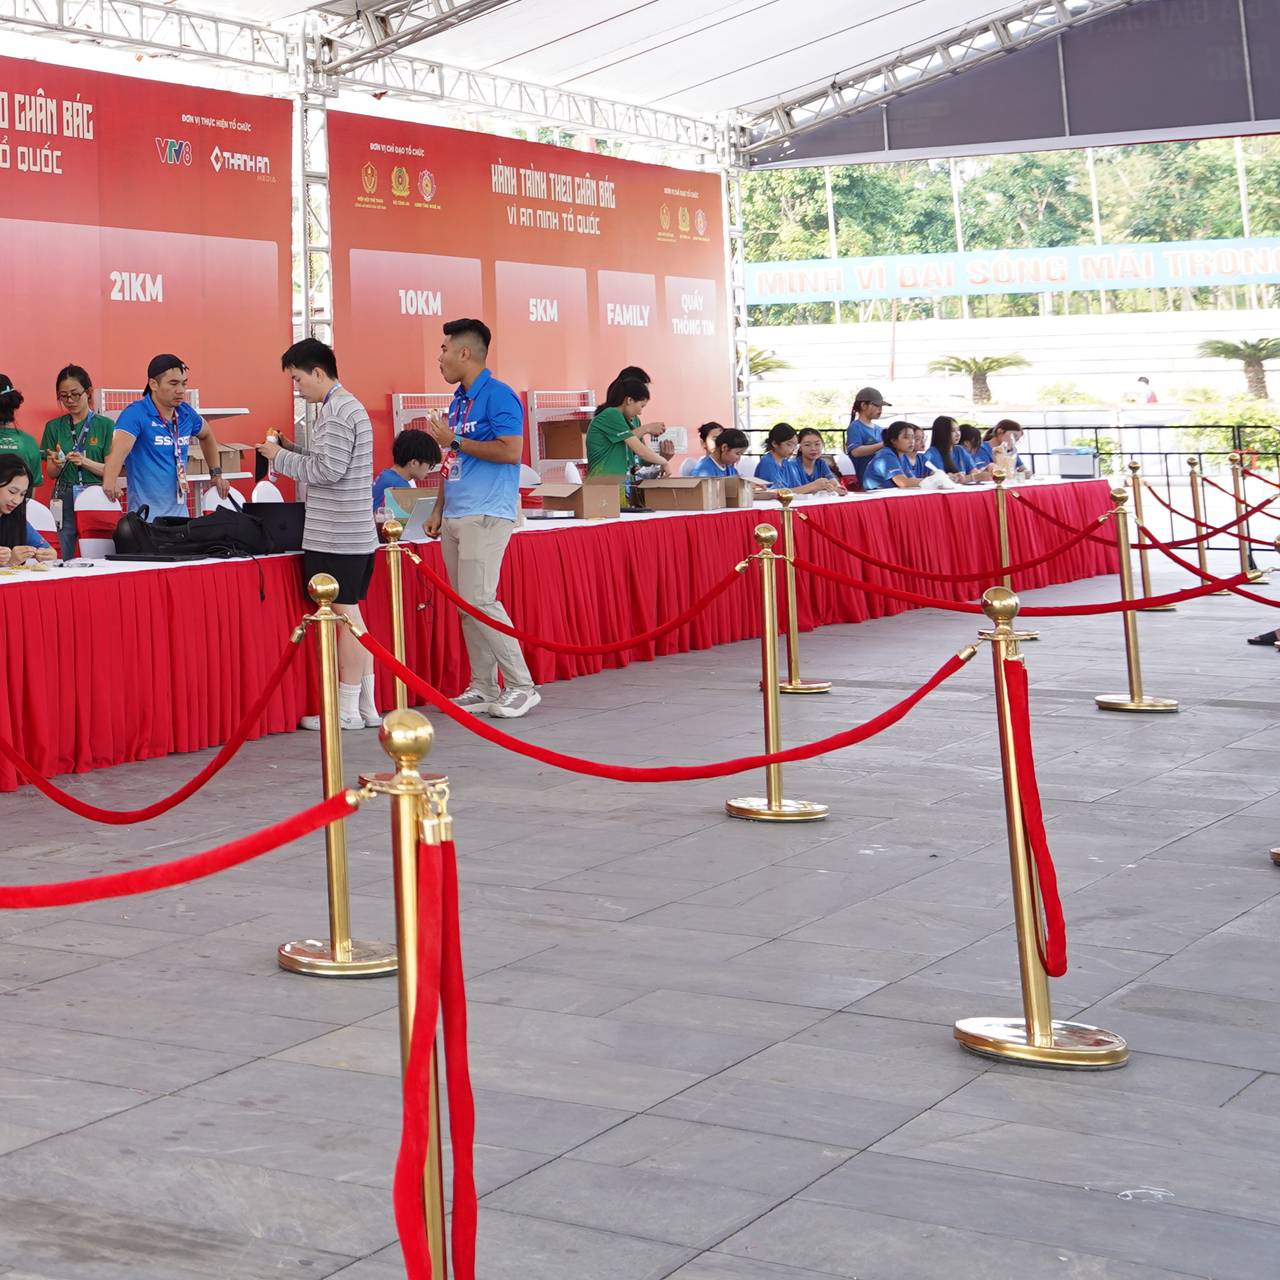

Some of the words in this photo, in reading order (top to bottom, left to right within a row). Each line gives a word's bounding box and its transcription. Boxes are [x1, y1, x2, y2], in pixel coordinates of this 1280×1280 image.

[14, 88, 57, 136] CHÂN
[63, 93, 94, 139] BÁC
[17, 141, 63, 174] QUỐC
[155, 137, 192, 166] VTV8
[223, 151, 255, 172] THANH
[256, 155, 270, 174] AN
[491, 157, 517, 195] HÀNH
[519, 162, 547, 199] TRÌNH
[549, 173, 573, 203] THEO
[574, 172, 597, 206] CHÂN
[598, 175, 616, 208] BÁC
[507, 203, 517, 225] VÌ
[520, 207, 534, 227] AN
[536, 209, 559, 230] NINH
[562, 207, 574, 232] TỔ
[576, 211, 601, 235] QUỐC
[757, 268, 844, 296] MINH
[1080, 248, 1154, 281] MÃI
[1164, 246, 1280, 278] TRON
[110, 272, 164, 303] 21KM
[398, 289, 442, 316] 10KM
[528, 298, 558, 322] 5KM
[606, 303, 650, 327] FAMILY
[702, 319, 715, 336] TIN
